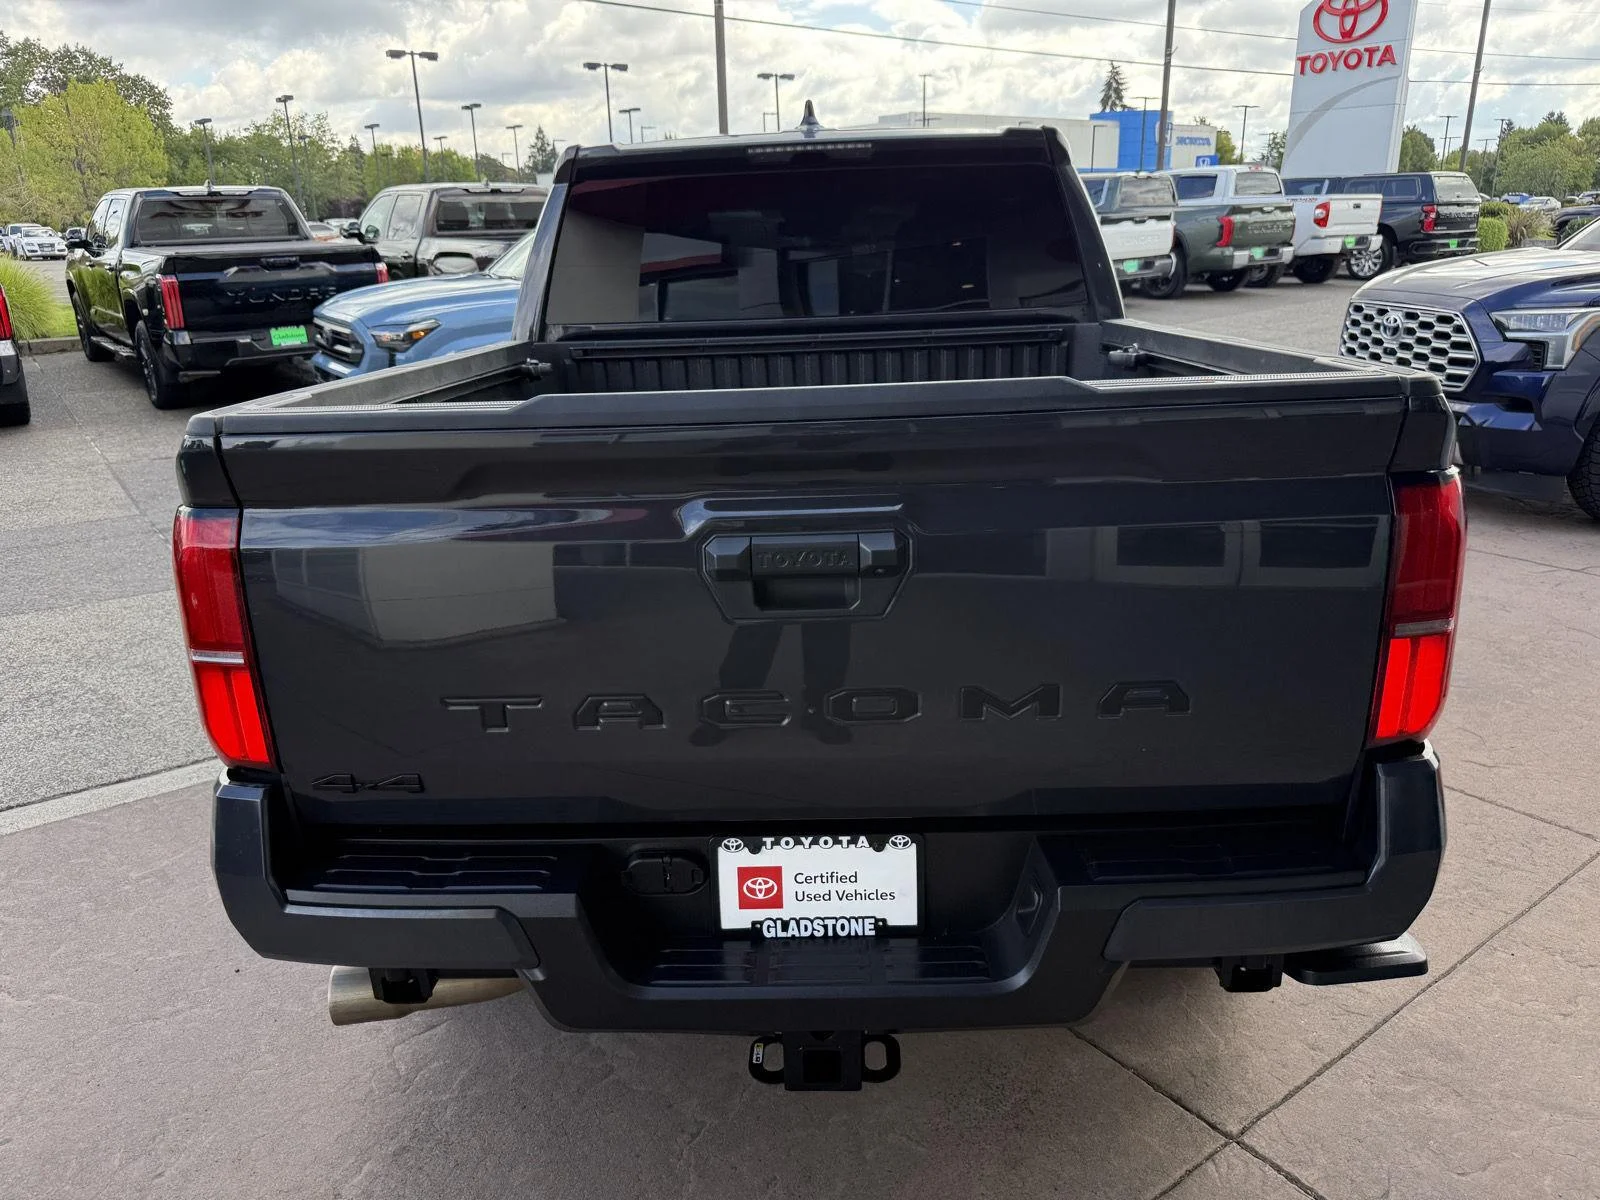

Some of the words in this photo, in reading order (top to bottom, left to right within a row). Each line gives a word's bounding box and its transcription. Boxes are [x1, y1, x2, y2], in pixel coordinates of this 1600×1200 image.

[1297, 44, 1397, 76] TOYOTA
[1175, 136, 1212, 146] HONDA
[758, 550, 855, 568] TOYOTA
[440, 680, 1191, 733] TACOMA
[762, 836, 870, 850] TOYOTA
[794, 871, 858, 884] Certified
[795, 890, 831, 902] Used
[835, 888, 896, 901] Vehicles
[762, 917, 876, 938] GLADSTONE
